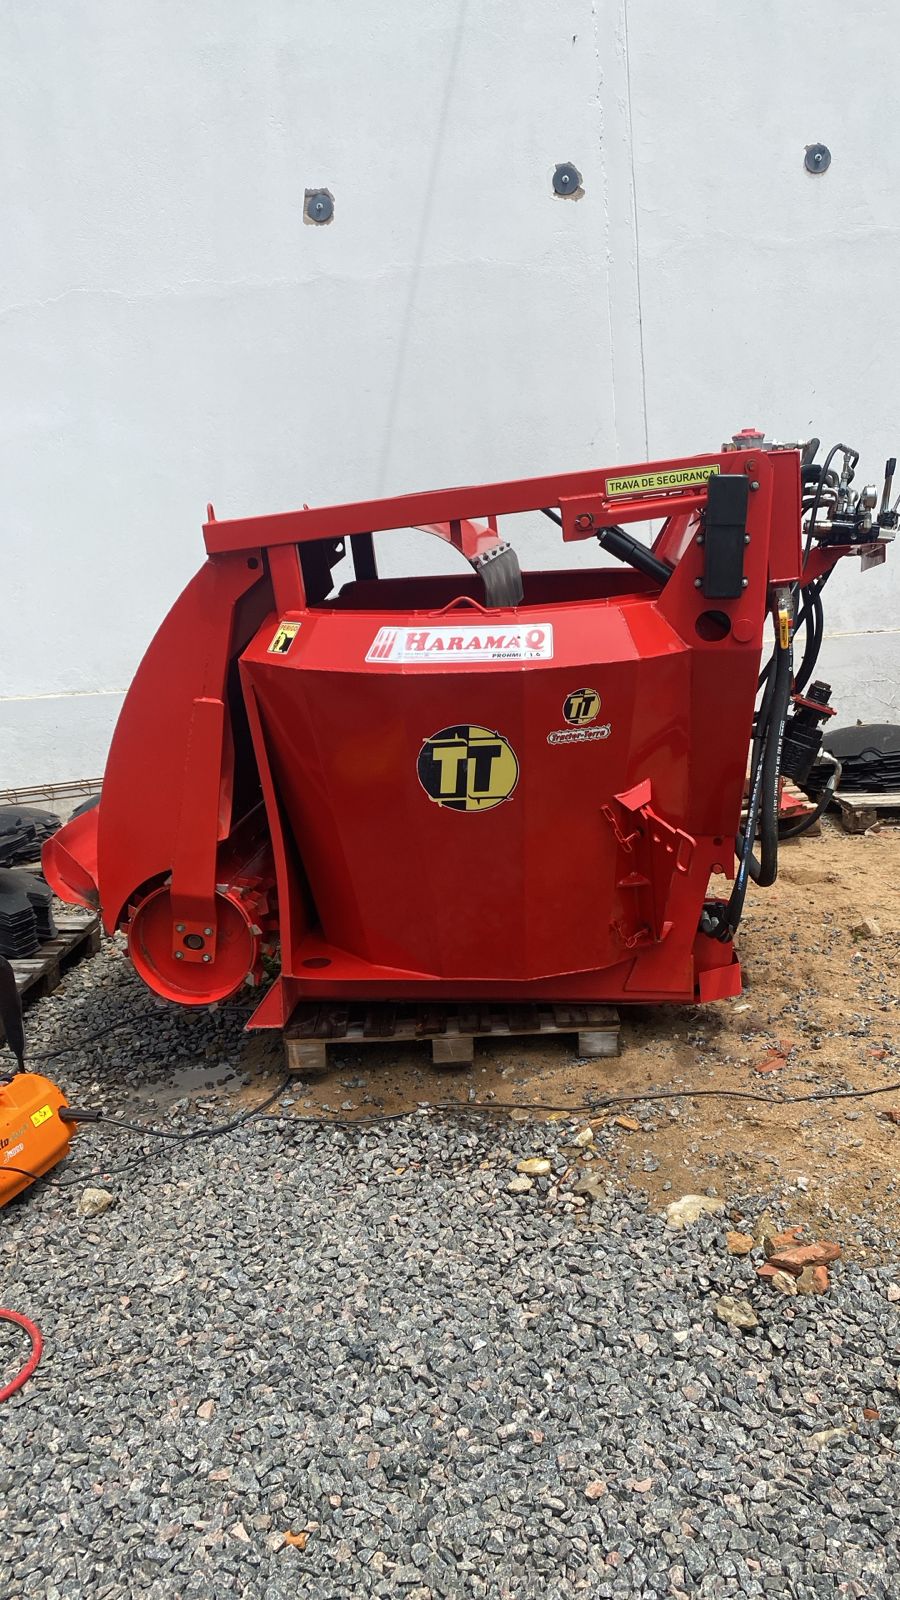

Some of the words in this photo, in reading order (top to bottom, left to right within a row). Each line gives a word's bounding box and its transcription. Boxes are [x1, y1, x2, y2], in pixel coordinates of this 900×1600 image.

[609, 480, 640, 492] TRAVA
[641, 478, 655, 488] DE
[404, 629, 546, 651] HARAMAQ
